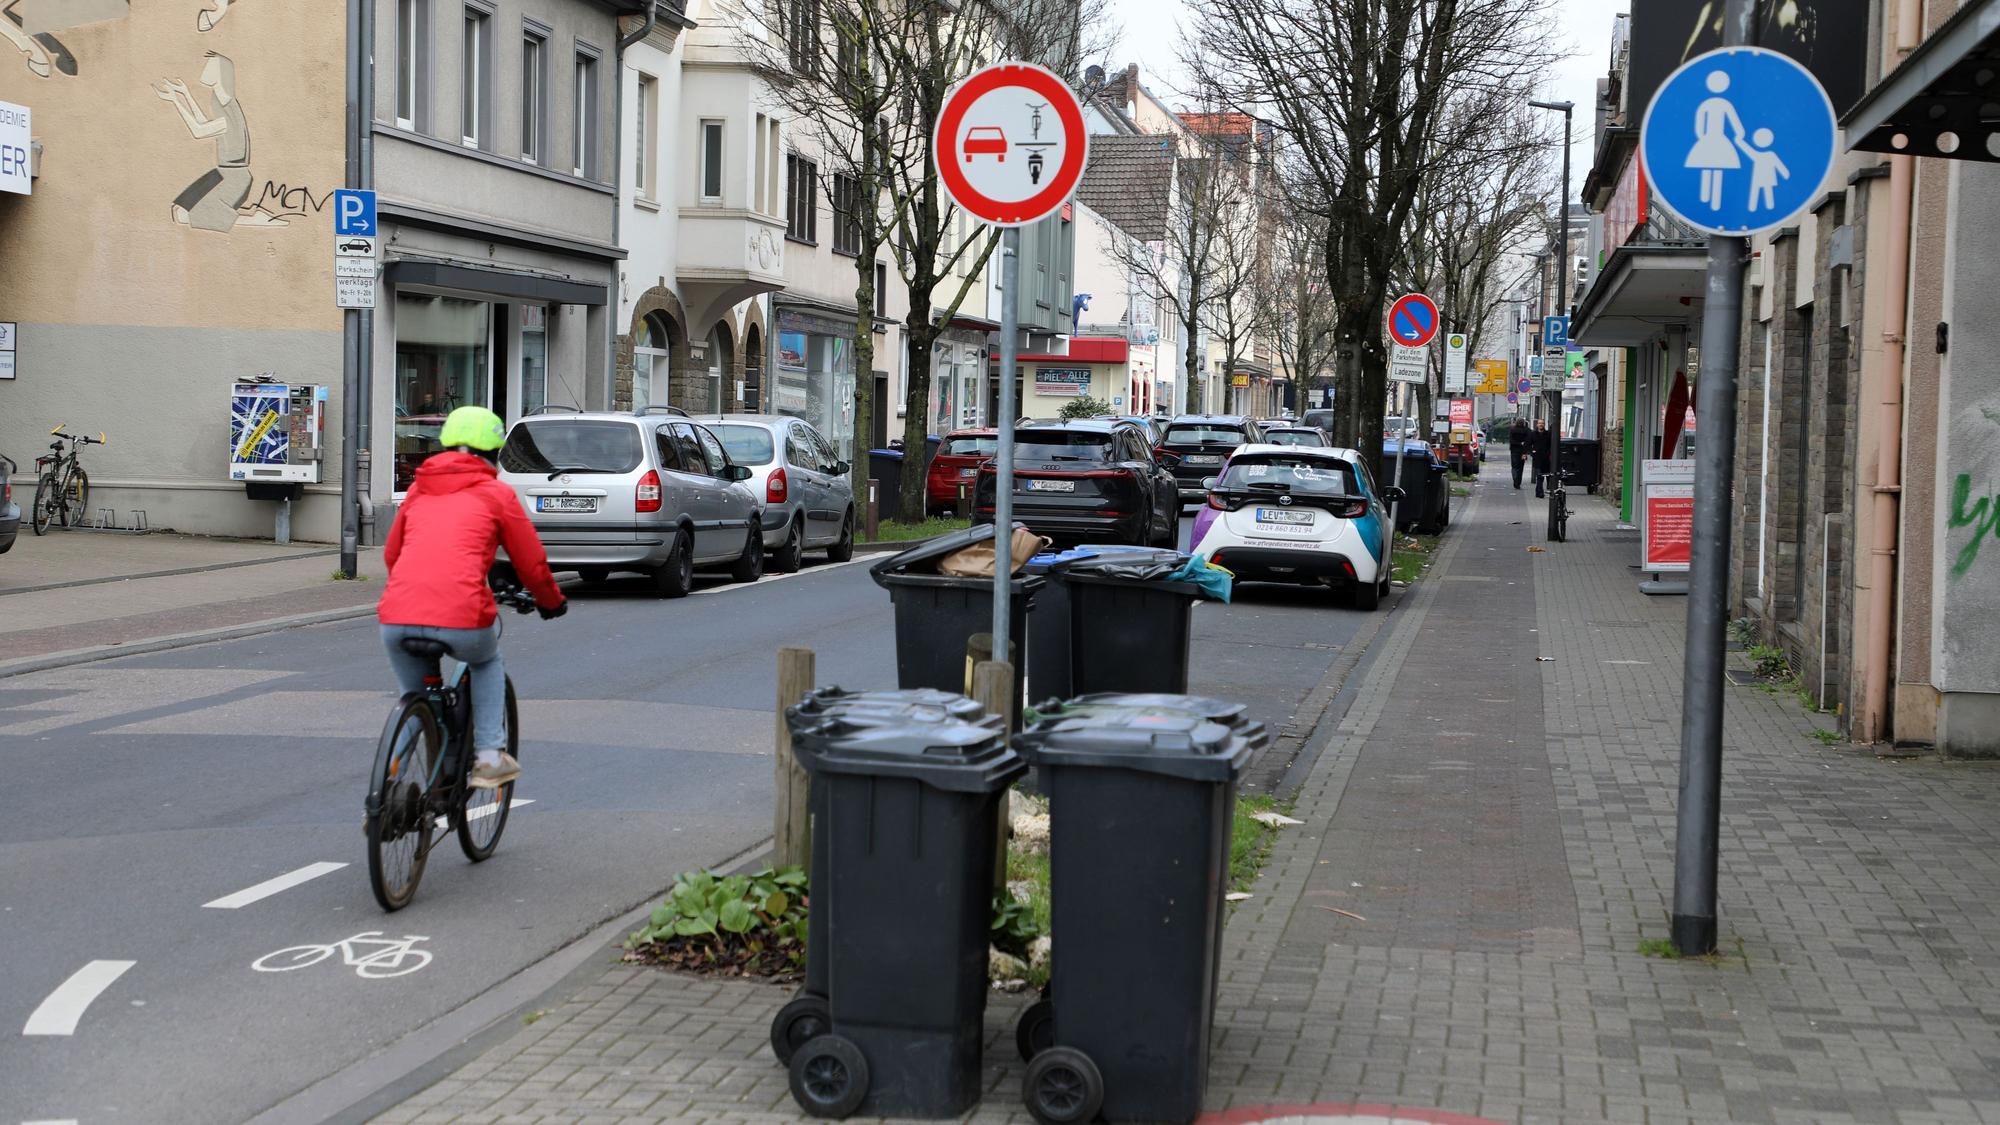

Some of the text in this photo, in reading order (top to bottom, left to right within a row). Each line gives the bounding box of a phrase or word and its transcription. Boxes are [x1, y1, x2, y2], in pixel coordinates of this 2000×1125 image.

[341, 195, 364, 230] P
[338, 279, 373, 287] werktags
[1549, 320, 1563, 342] P
[1394, 367, 1422, 377] Ladezone
[543, 498, 555, 508] GL
[1262, 510, 1279, 520] LEV
